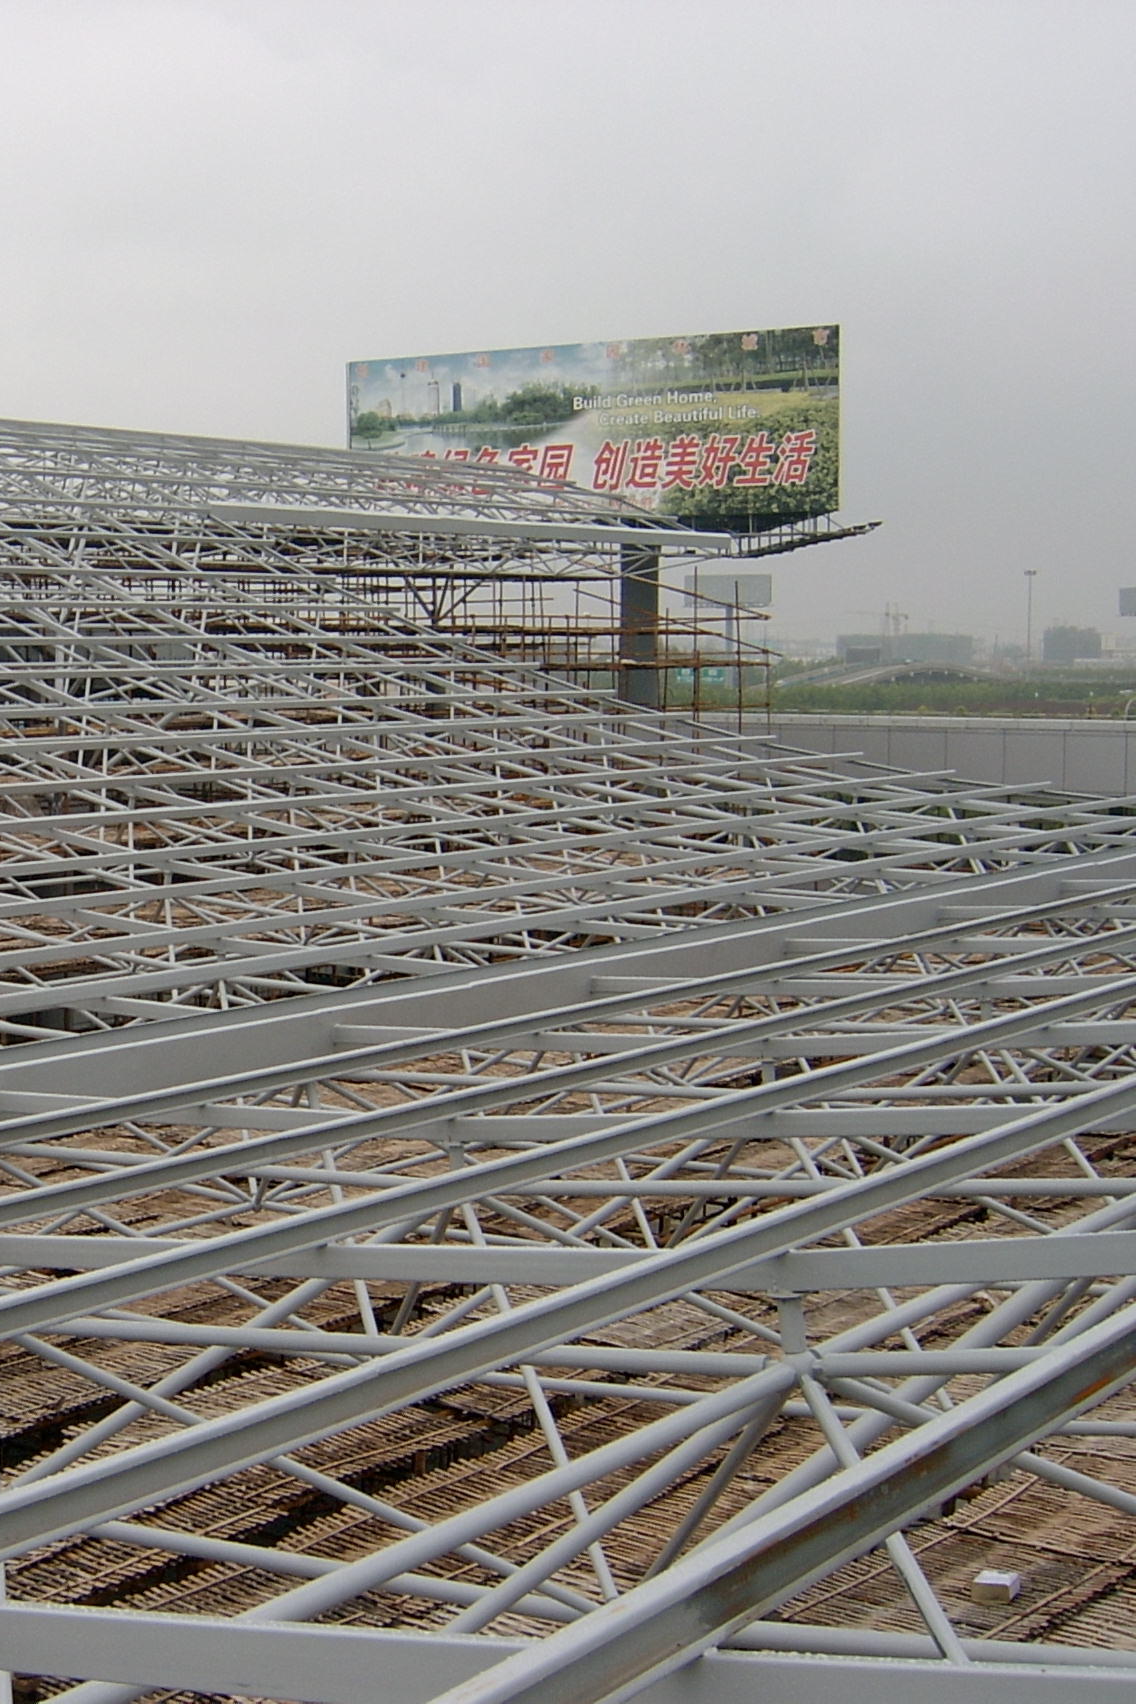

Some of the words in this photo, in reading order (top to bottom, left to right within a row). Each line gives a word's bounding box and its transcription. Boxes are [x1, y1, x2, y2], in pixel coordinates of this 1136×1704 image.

[572, 395, 612, 410] Build
[616, 393, 662, 408] Green
[599, 412, 649, 426] Create
[653, 407, 723, 425] Beautiful
[593, 429, 816, 491] 创造美好生活
